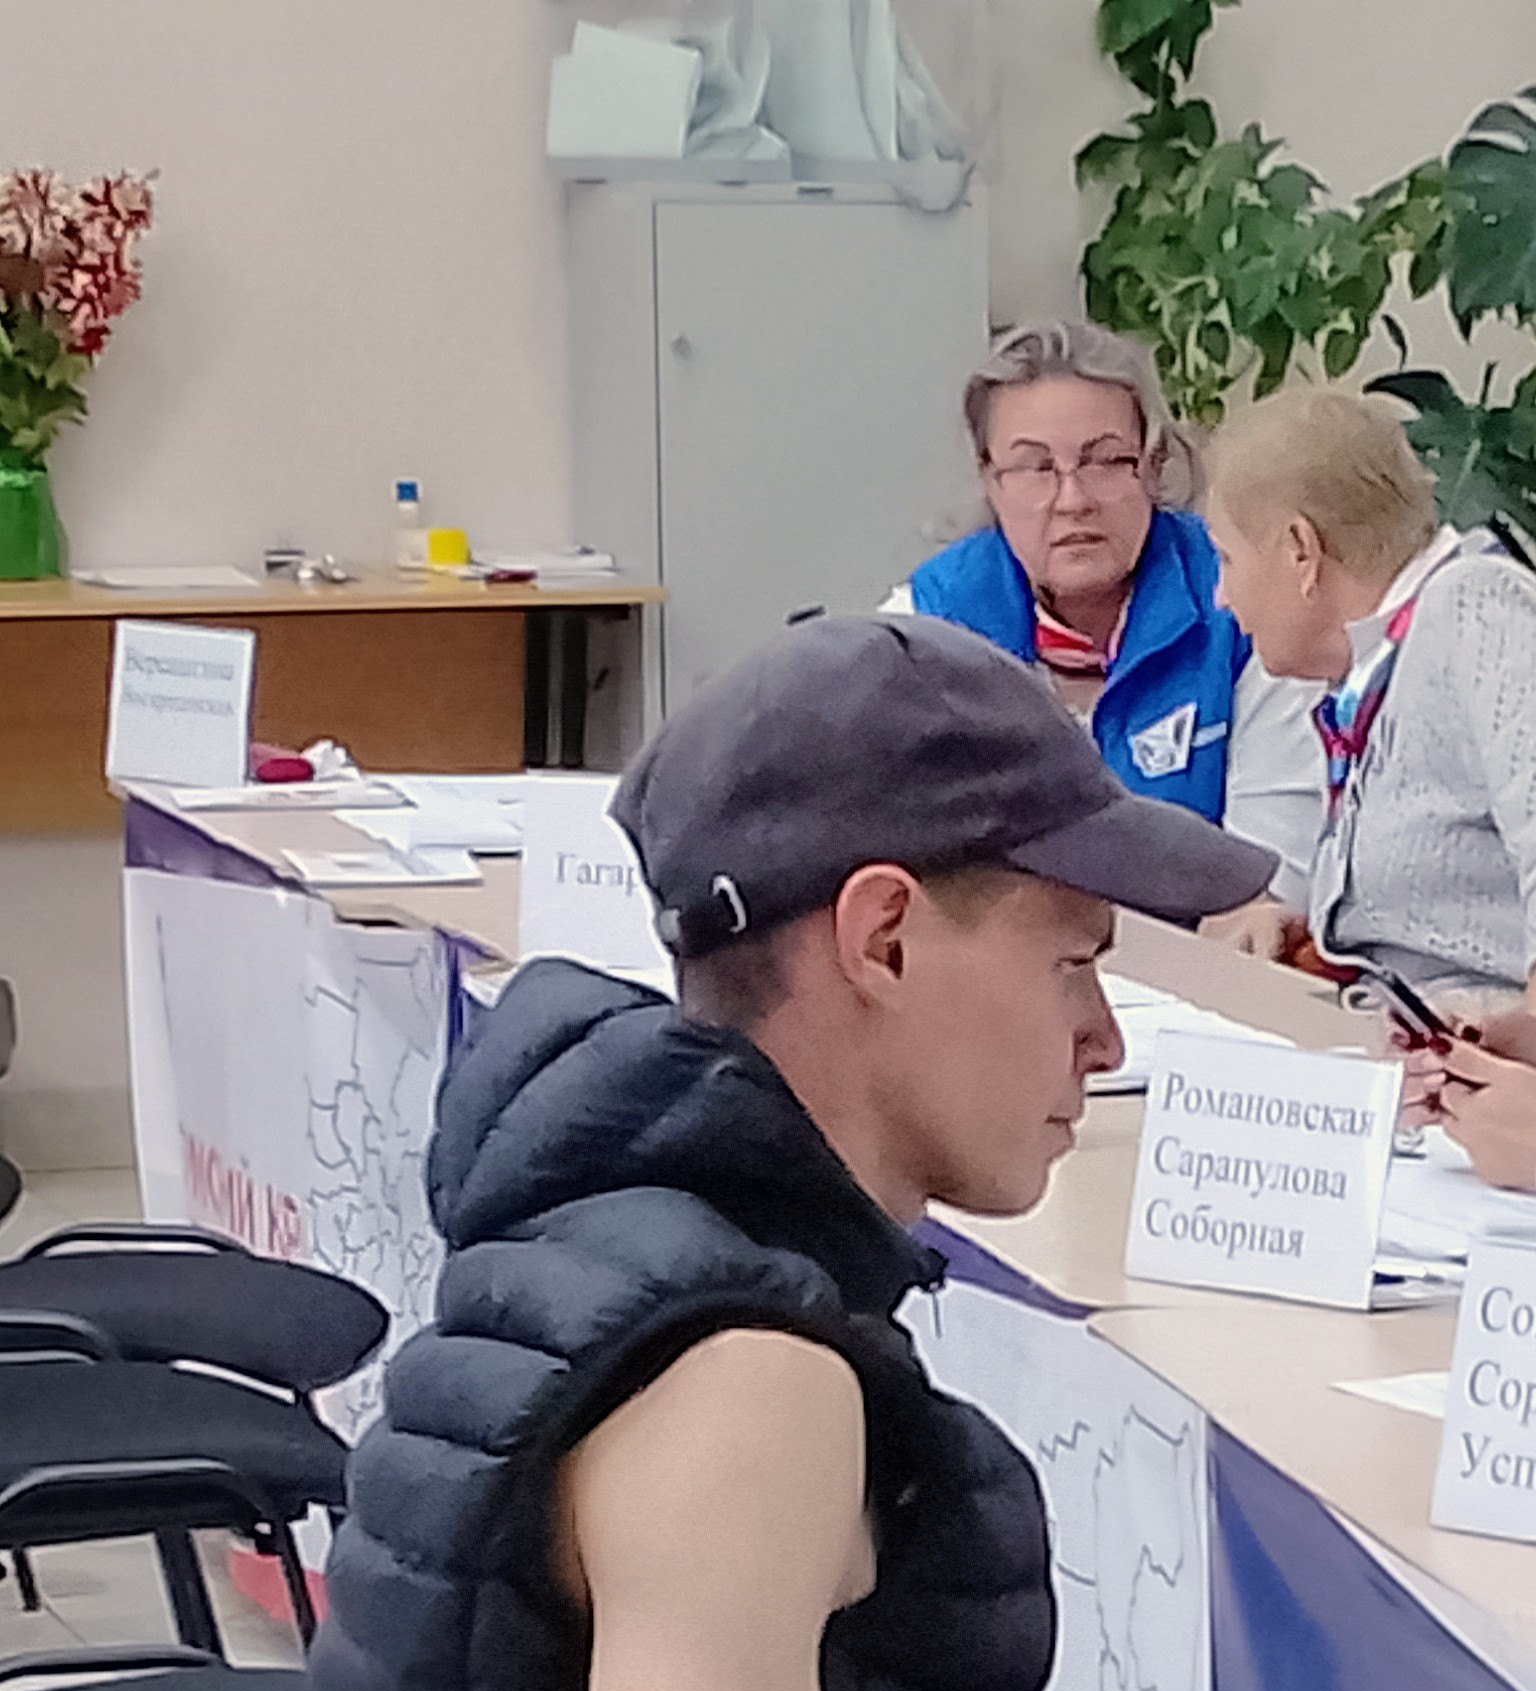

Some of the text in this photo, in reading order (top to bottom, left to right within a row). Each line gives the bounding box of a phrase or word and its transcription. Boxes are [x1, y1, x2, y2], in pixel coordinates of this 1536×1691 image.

[556, 850, 640, 897] Гагар
[1162, 1071, 1377, 1137] Романовская
[1154, 1135, 1348, 1200] Сарапулова
[1145, 1198, 1304, 1260] Соборная
